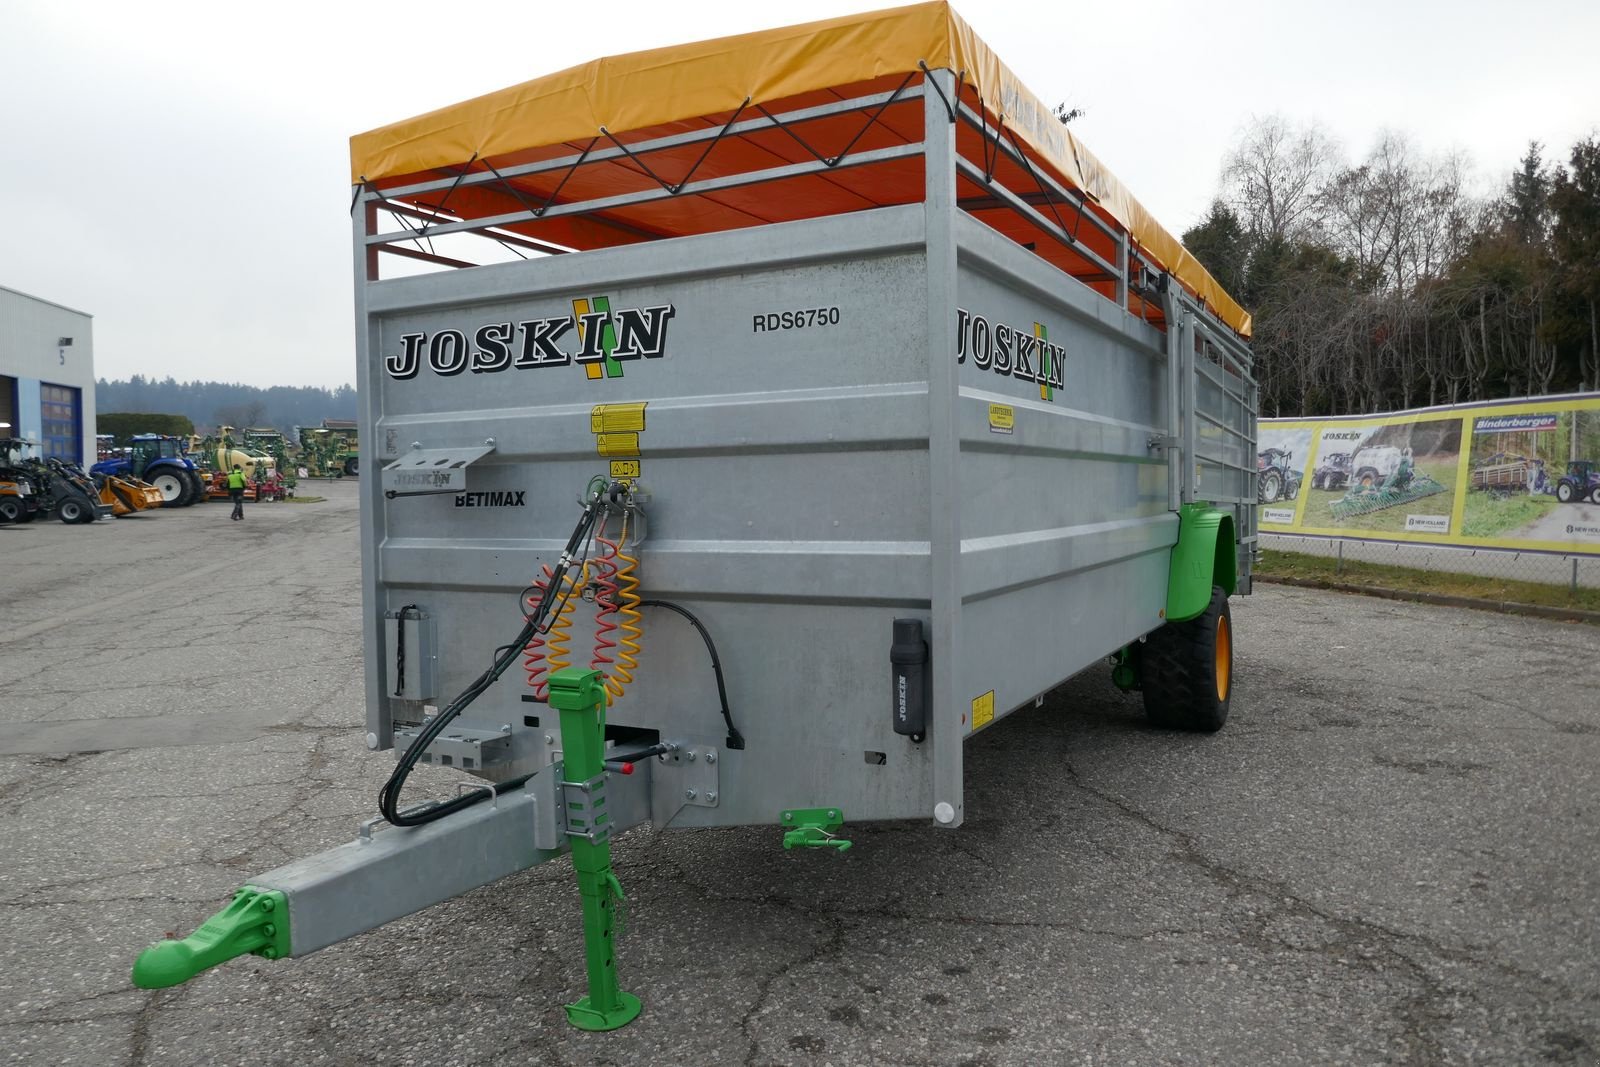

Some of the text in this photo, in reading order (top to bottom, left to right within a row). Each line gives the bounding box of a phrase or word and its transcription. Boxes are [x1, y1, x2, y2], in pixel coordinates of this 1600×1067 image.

[753, 307, 840, 332] RDS6750
[385, 303, 676, 380] JOSKIN
[957, 308, 1066, 390] JOSKIN
[1476, 417, 1555, 429] Binderberger
[1323, 432, 1361, 440] JOSKIN
[394, 472, 451, 486] JOSKIN
[455, 491, 525, 507] BETIMAX
